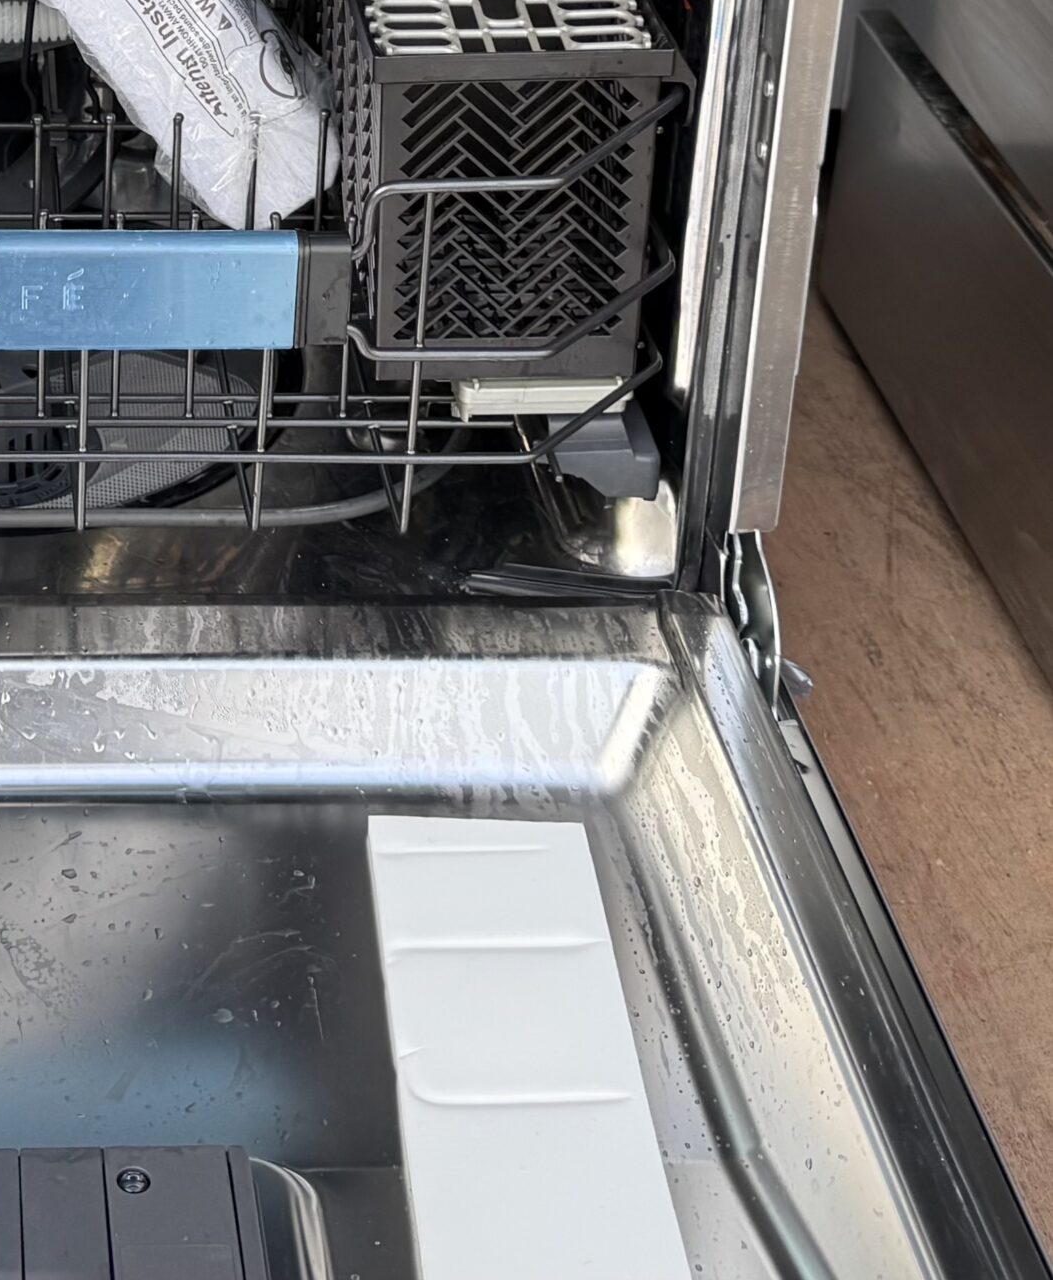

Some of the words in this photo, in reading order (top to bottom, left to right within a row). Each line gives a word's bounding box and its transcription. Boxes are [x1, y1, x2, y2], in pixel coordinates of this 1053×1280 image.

[157, 0, 179, 26] AWAY!
[178, 13, 199, 38] sound
[241, 20, 257, 40] This
